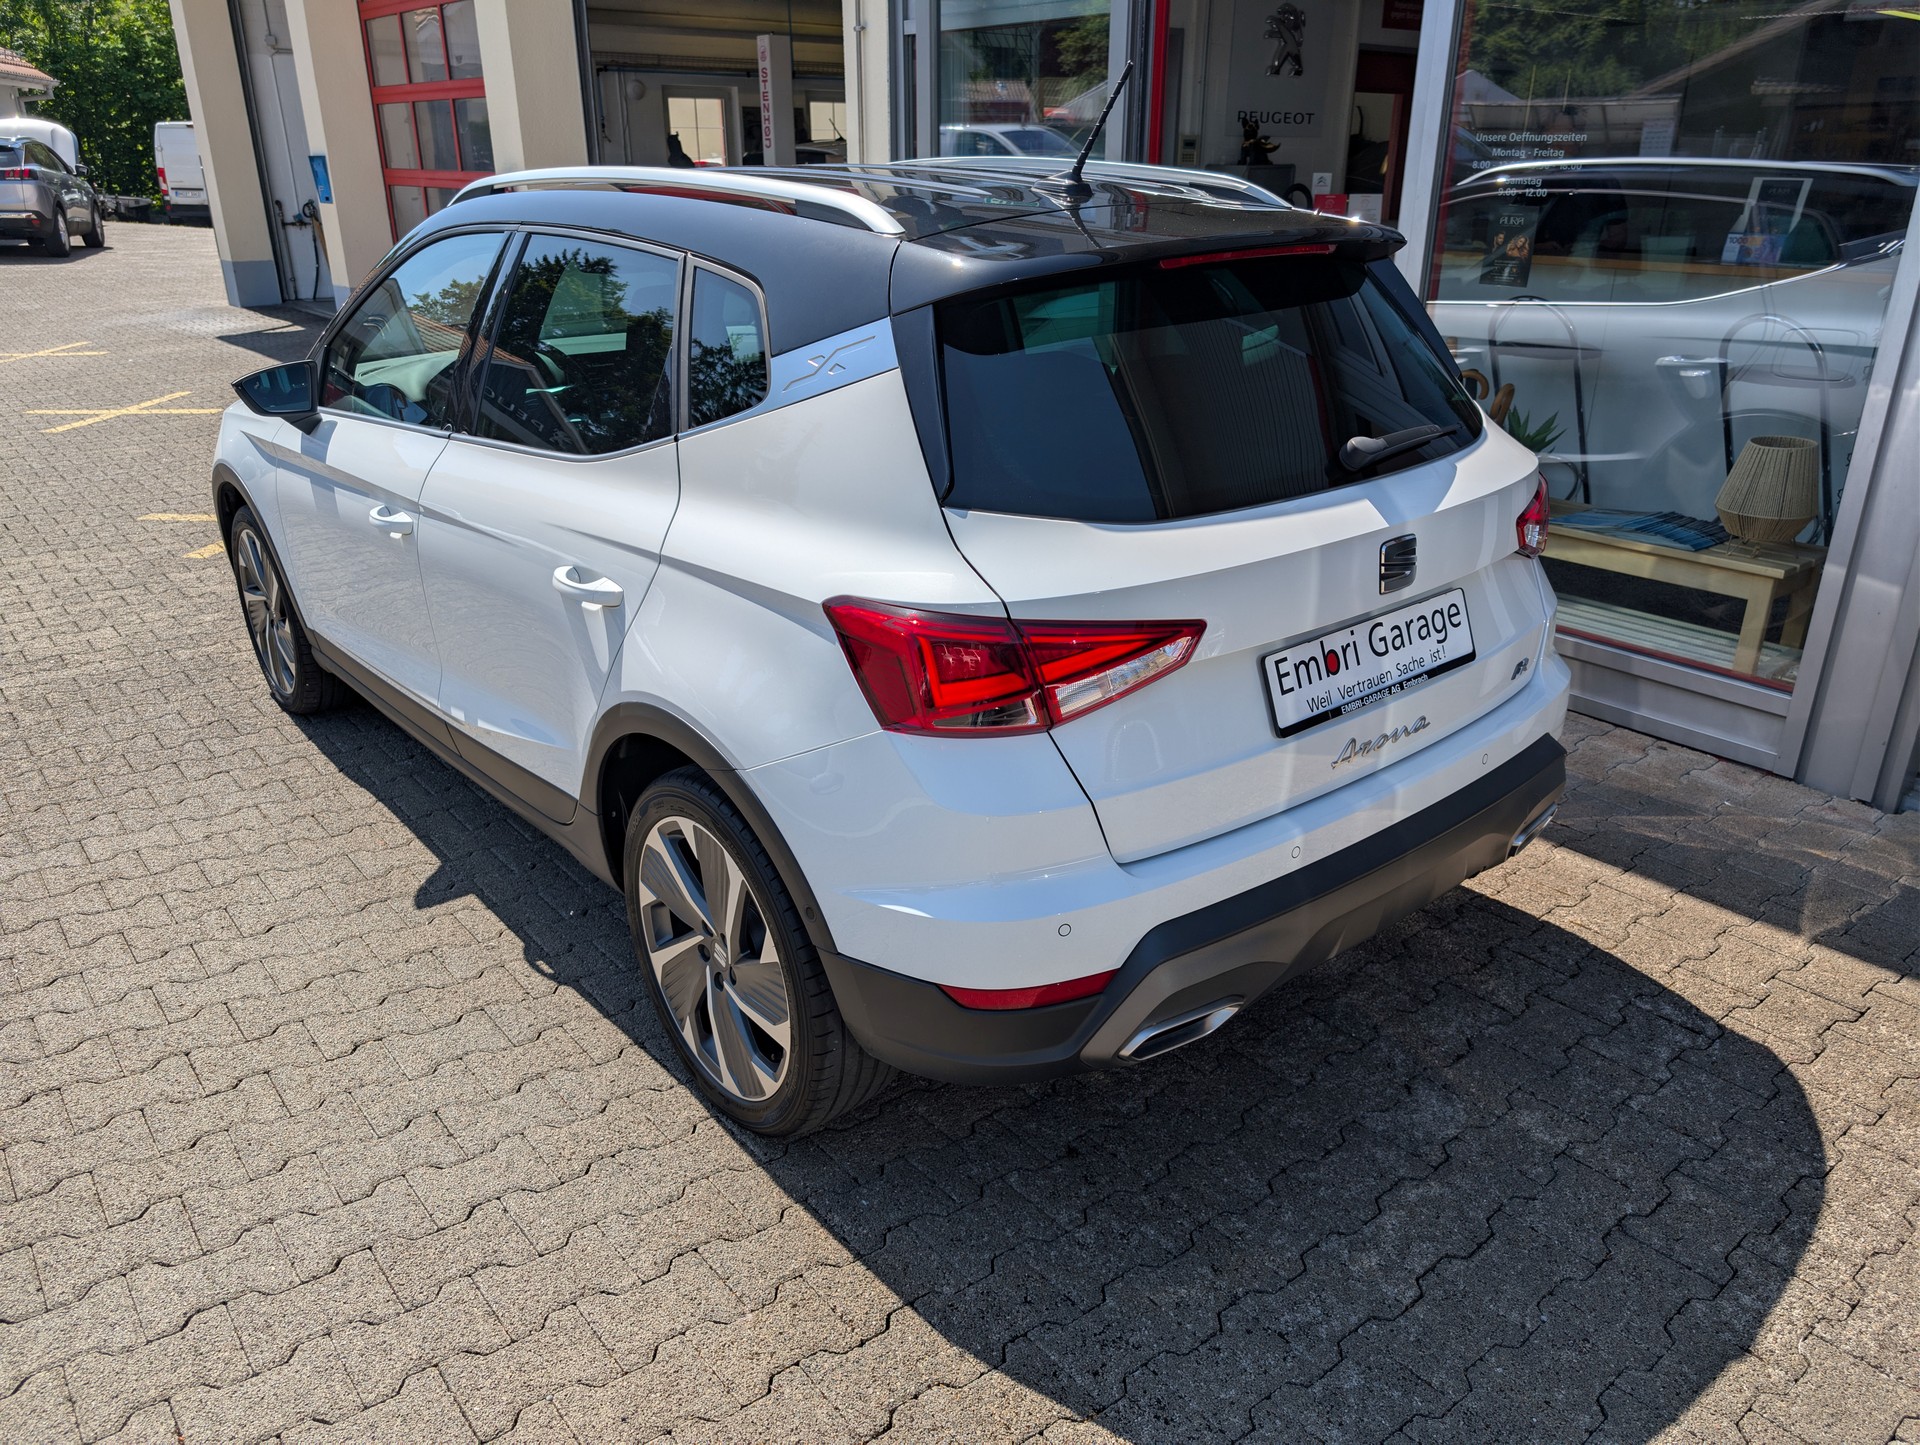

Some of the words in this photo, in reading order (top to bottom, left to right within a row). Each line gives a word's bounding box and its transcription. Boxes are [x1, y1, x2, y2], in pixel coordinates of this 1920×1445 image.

[1237, 110, 1315, 125] PEUGEOT
[1476, 132, 1506, 142] Unsere
[1509, 132, 1587, 144] Oeffnungszeiten
[1492, 148, 1526, 158] Montag
[1533, 148, 1565, 158] Freitag
[1472, 161, 1490, 169] 8.00
[1504, 177, 1542, 187] Samstag
[1525, 189, 1547, 197] 12.00
[1273, 629, 1361, 695] Embri
[1368, 602, 1462, 657] Garage
[1306, 688, 1333, 713] Weil
[1337, 669, 1393, 701] Vertrauen
[1396, 655, 1425, 678] Sache
[1391, 683, 1401, 695] AG
[1402, 673, 1428, 690] Embrach
[1330, 714, 1431, 769] Arona
